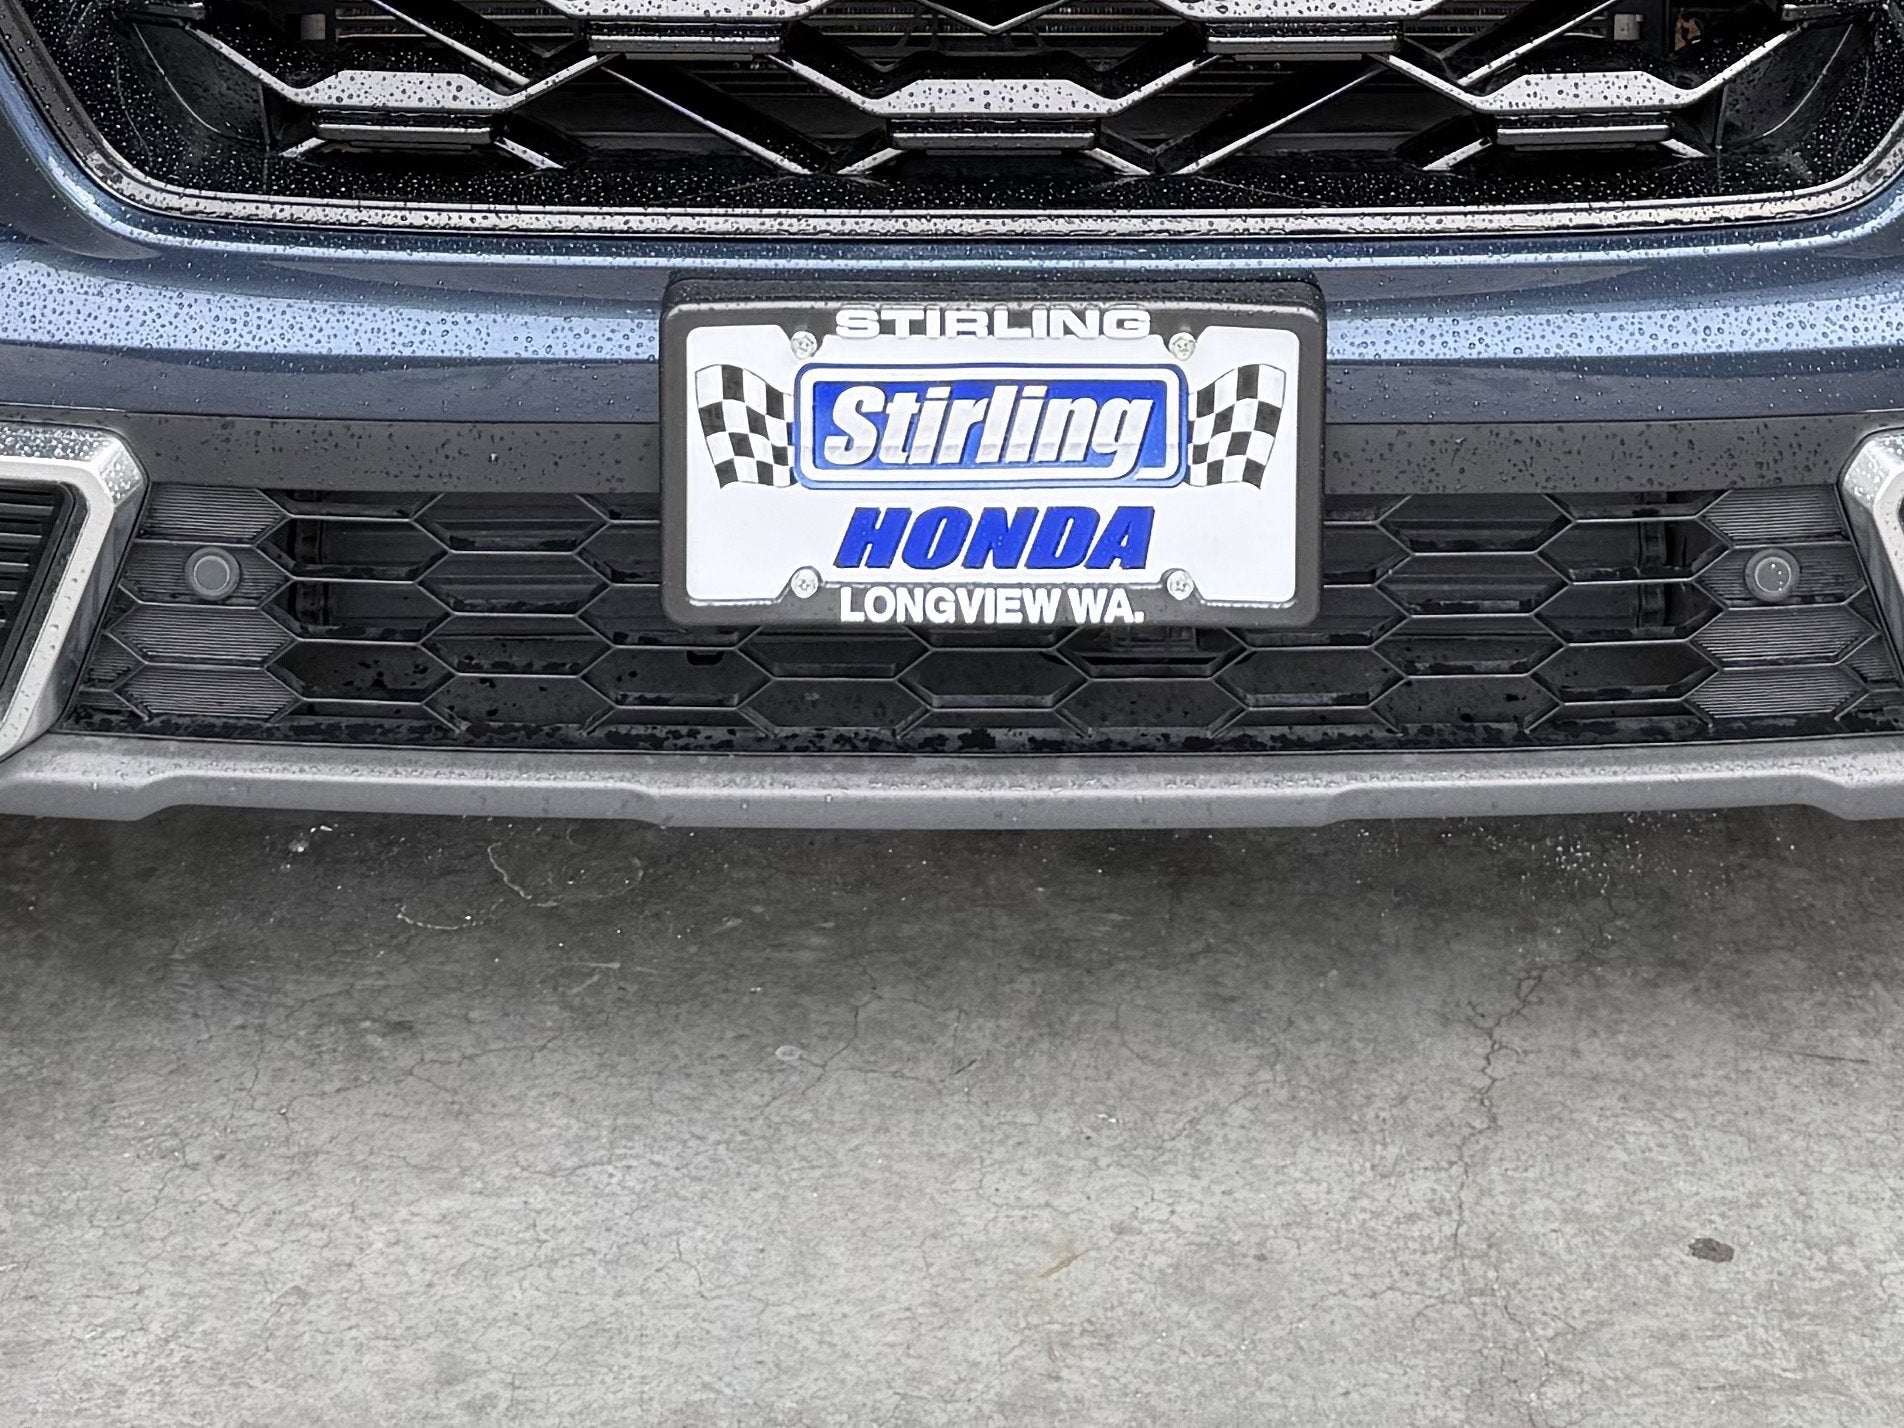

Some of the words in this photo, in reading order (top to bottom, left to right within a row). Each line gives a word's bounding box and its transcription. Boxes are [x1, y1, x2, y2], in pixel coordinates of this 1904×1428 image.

[835, 305, 1151, 340] STIRLING
[823, 385, 1154, 474] Stirling
[833, 506, 1155, 570] HONDA
[840, 586, 1063, 624] LONGVIEW
[1067, 586, 1145, 624] WA.
